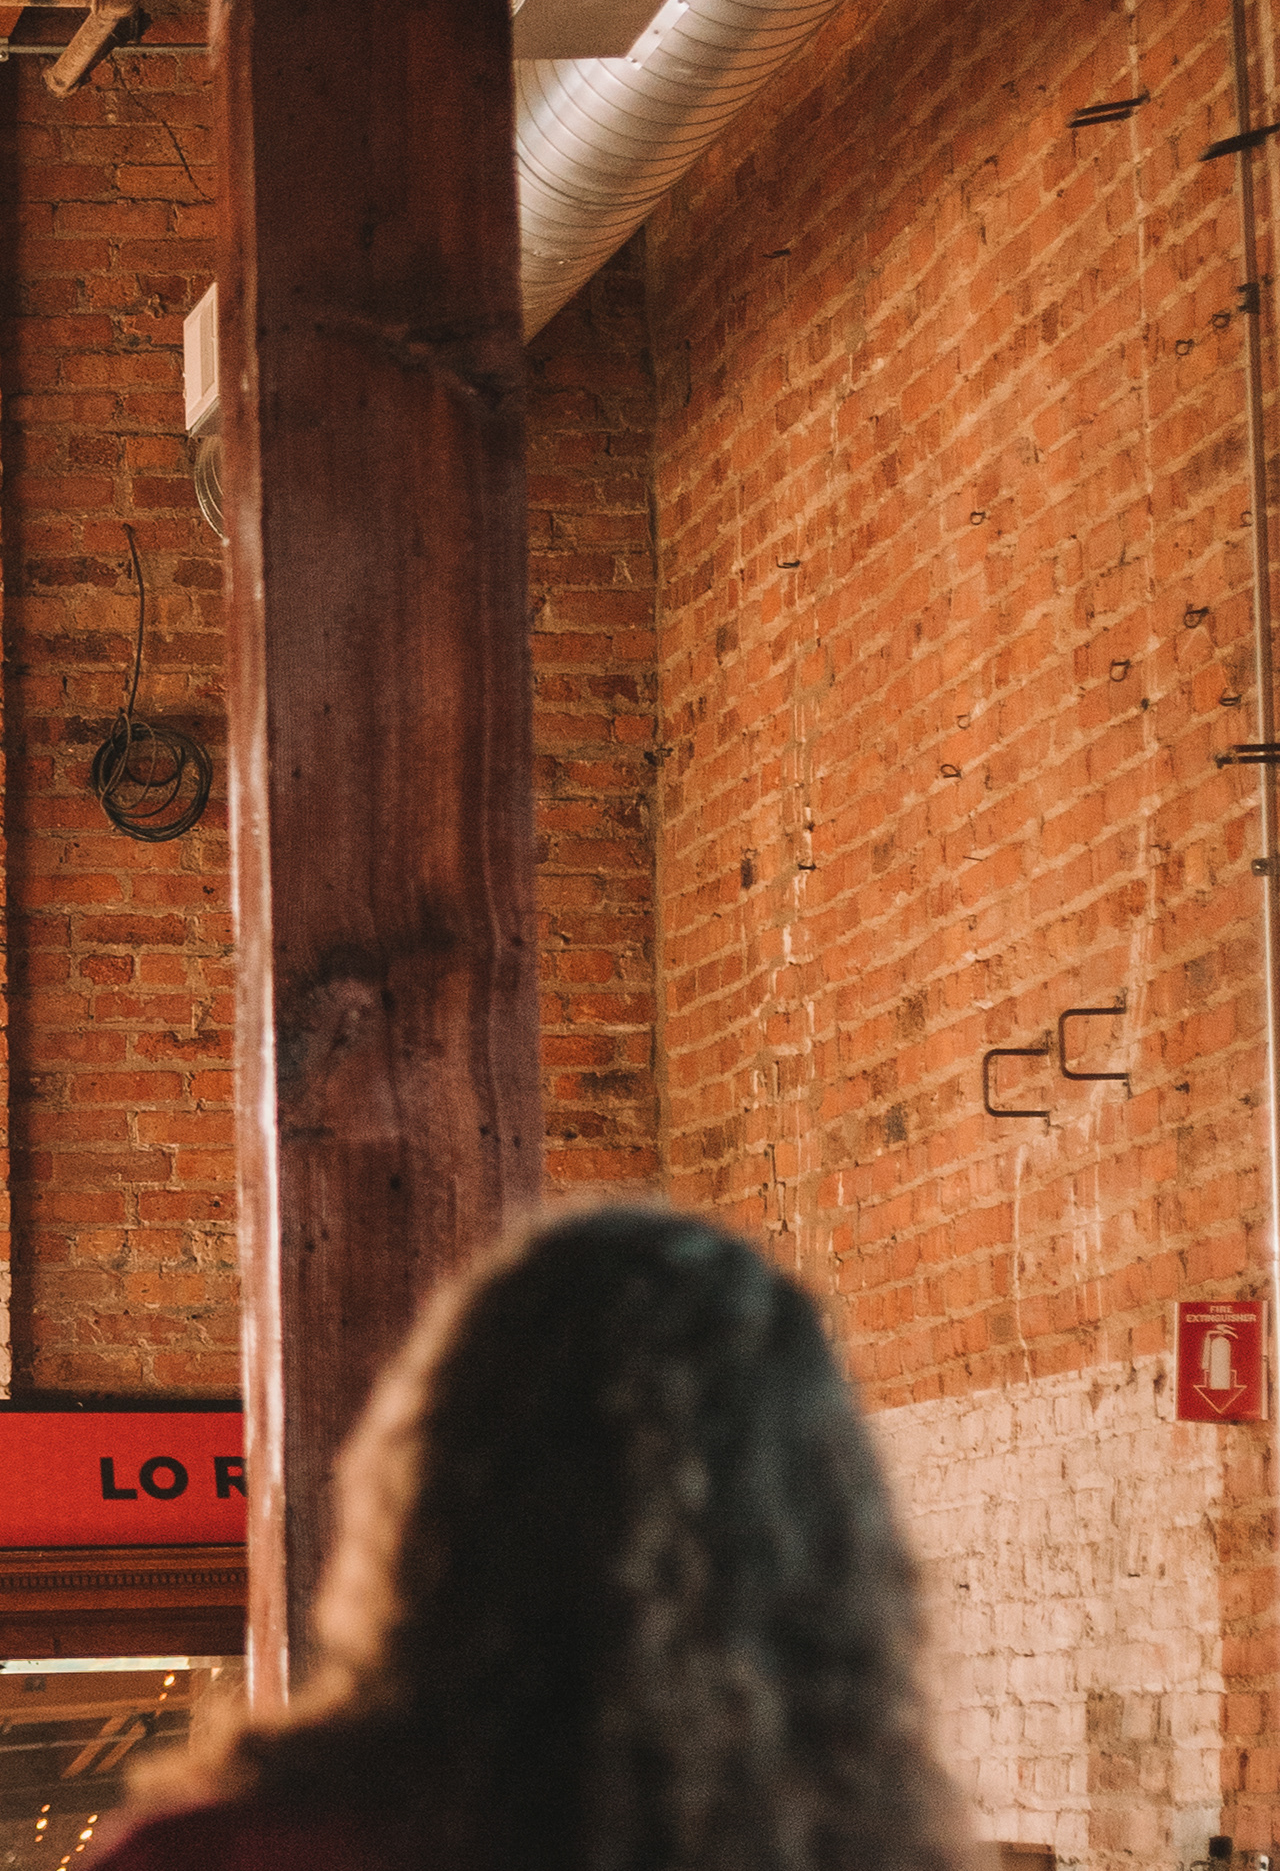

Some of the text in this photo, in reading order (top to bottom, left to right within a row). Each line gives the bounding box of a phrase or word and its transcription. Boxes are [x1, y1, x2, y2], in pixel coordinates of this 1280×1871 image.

[1209, 1305, 1234, 1314] FIRE
[1186, 1313, 1257, 1323] EXTINGUISHER
[99, 1456, 189, 1500] LO
